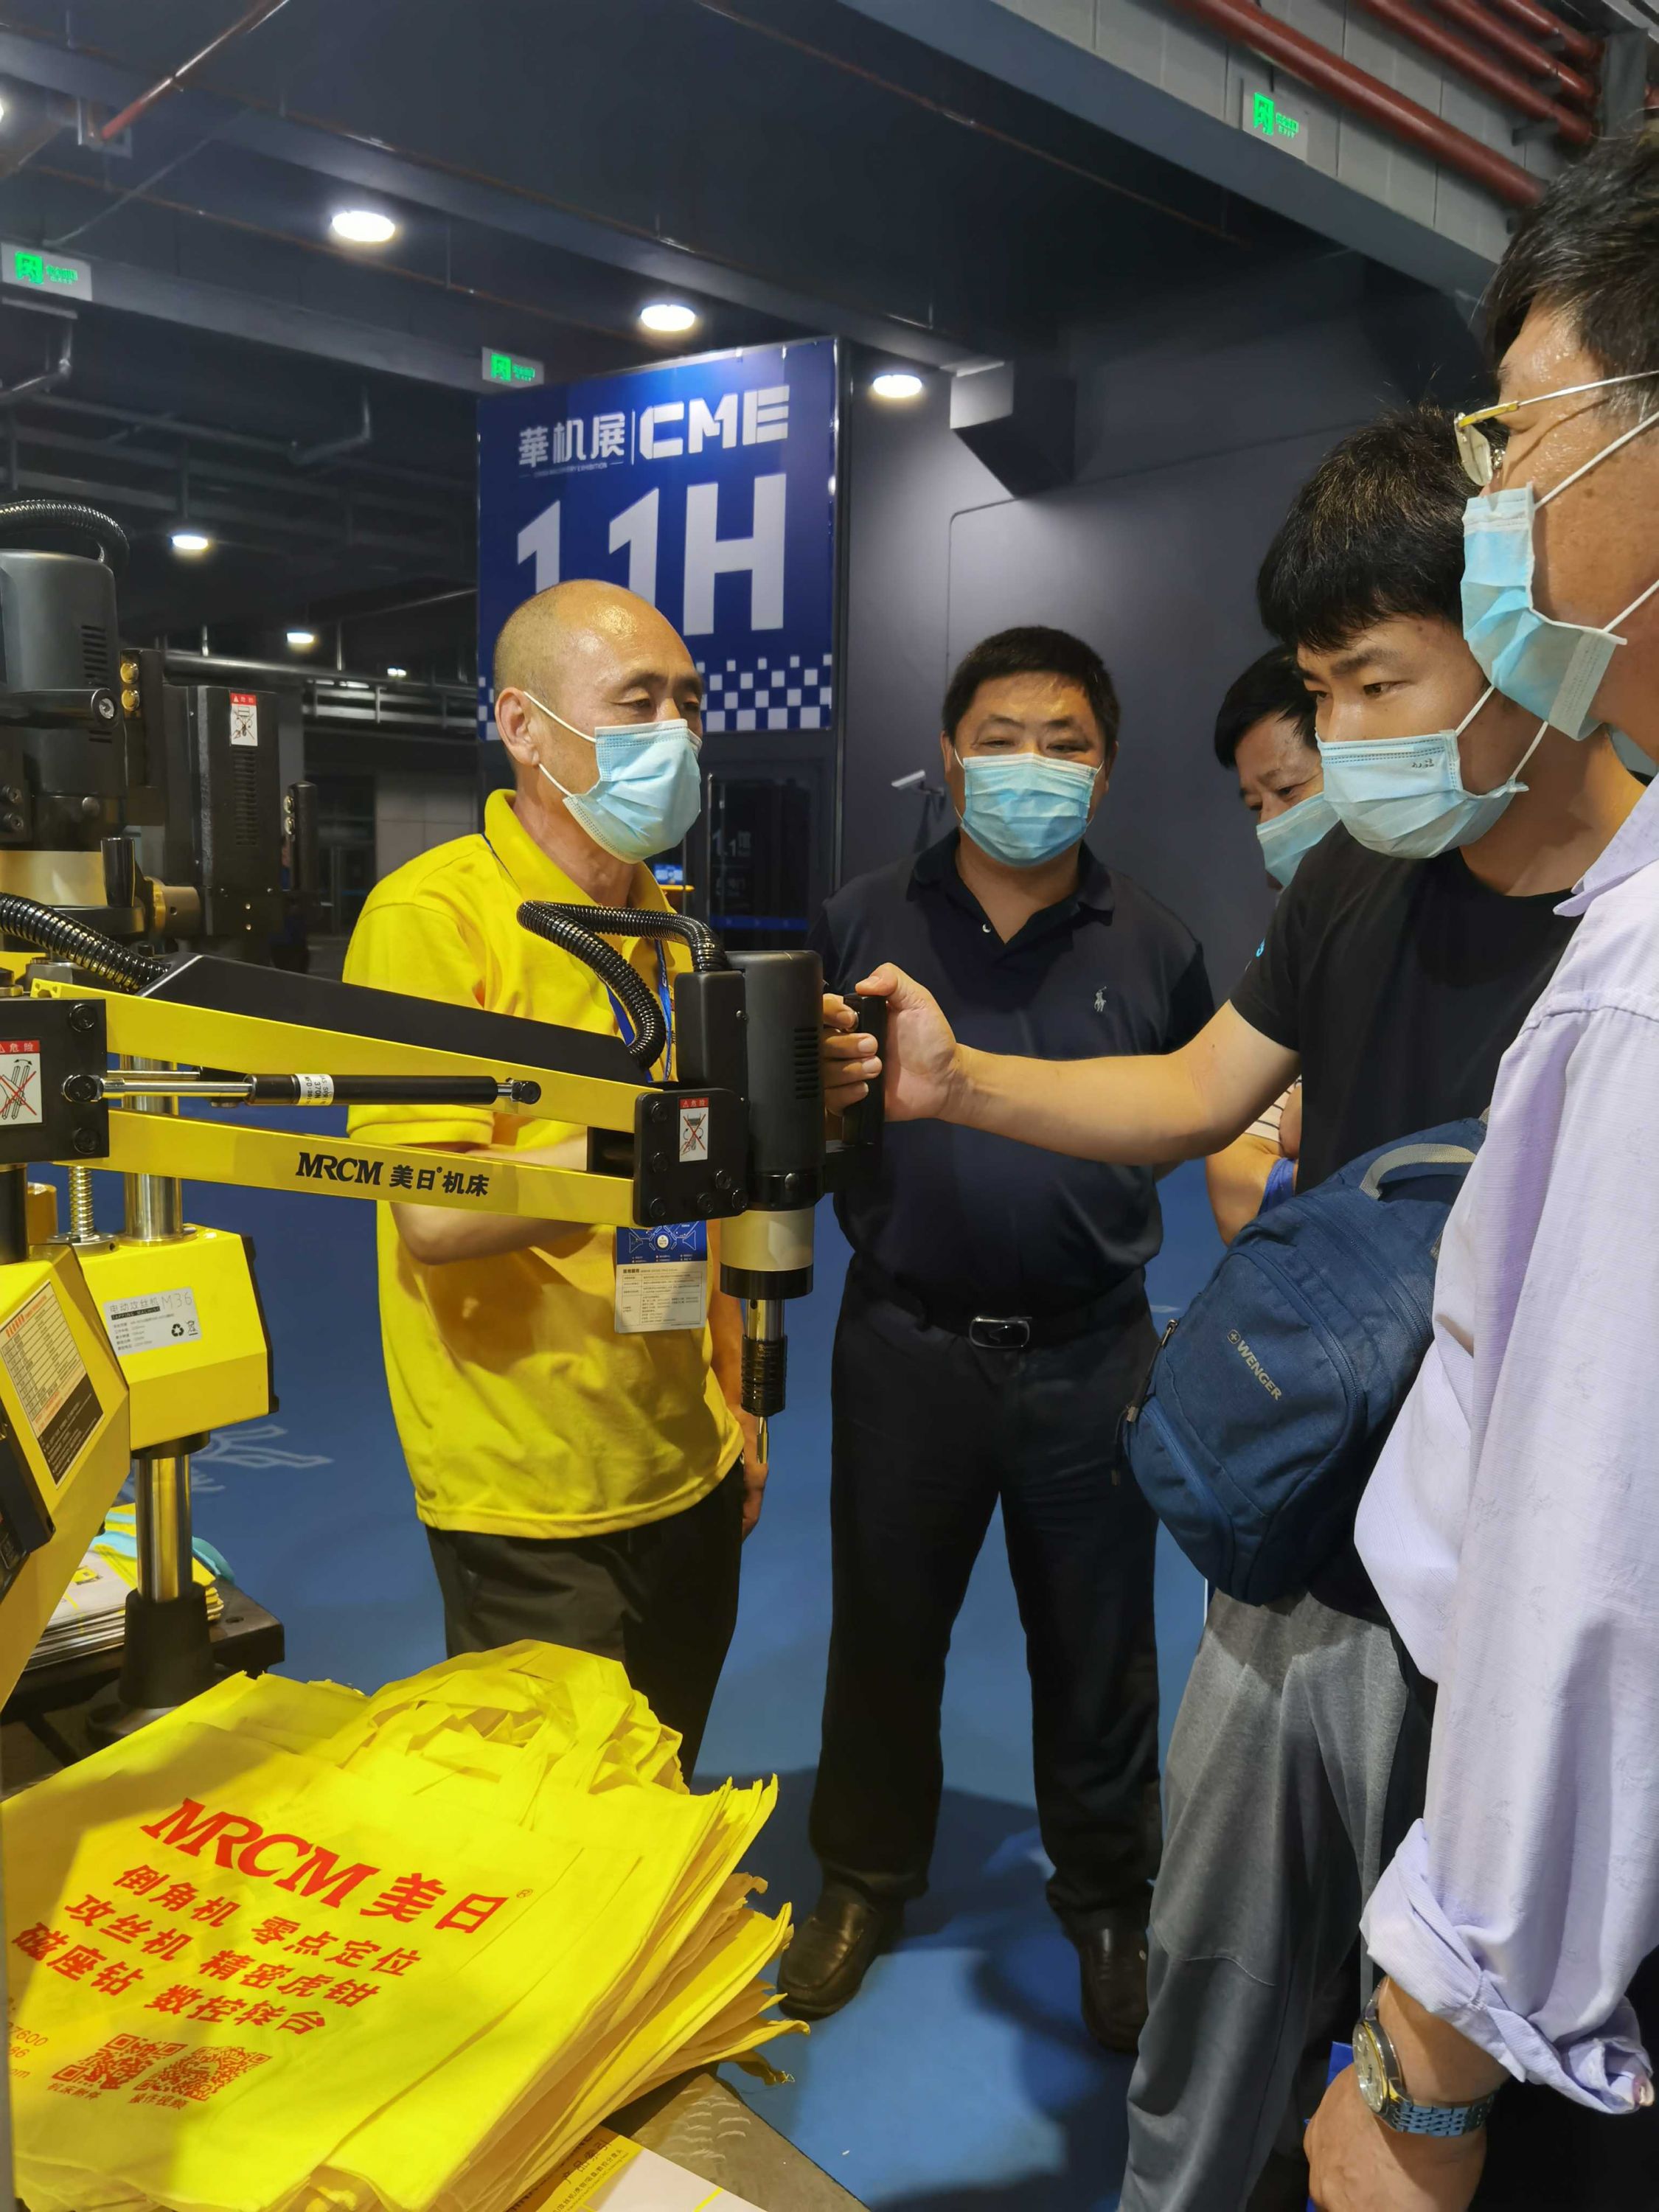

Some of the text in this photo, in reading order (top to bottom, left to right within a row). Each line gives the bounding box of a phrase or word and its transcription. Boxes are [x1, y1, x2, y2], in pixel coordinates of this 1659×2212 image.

[519, 412, 625, 467] 華机展
[639, 385, 790, 460] CME
[10, 1042, 35, 1053] 危险
[314, 1081, 322, 1099] 370N
[296, 1152, 384, 1186] MRCM
[161, 1291, 192, 1310] M36
[1237, 1339, 1282, 1401] WENGER
[139, 1797, 381, 1909] MRCM
[64, 1893, 381, 2008] 攻丝机 精密虎钳
[113, 1864, 422, 1976] 倒角机 零点定位
[11, 1921, 326, 2036] 磁座钻 数控转台
